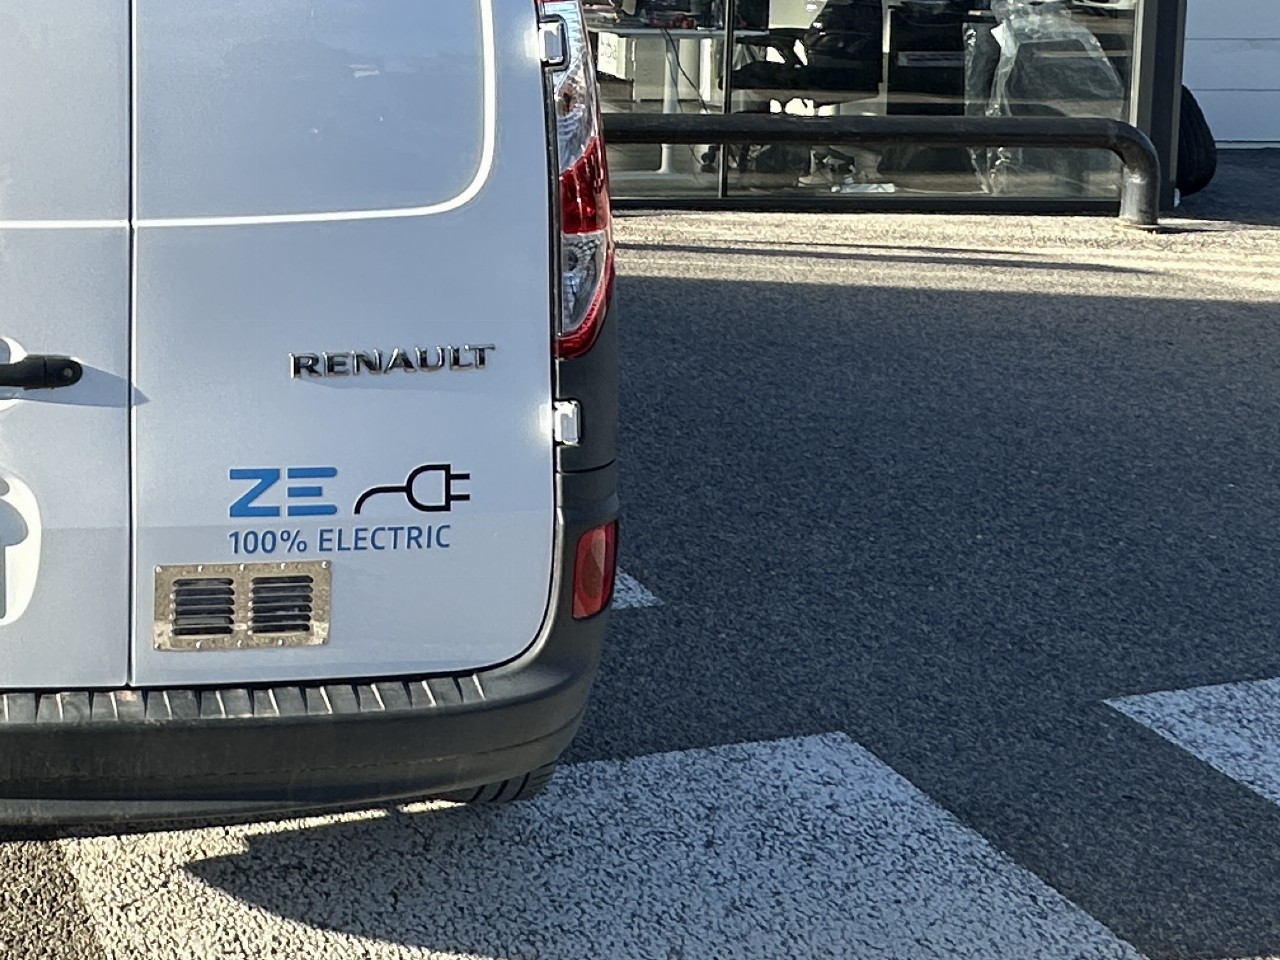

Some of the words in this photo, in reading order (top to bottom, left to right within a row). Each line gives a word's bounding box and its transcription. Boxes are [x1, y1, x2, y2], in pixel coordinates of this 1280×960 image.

[288, 343, 496, 380] RENAULT
[228, 466, 338, 518] ZE
[228, 528, 308, 555] 100%
[317, 524, 452, 554] ELECTRIC
